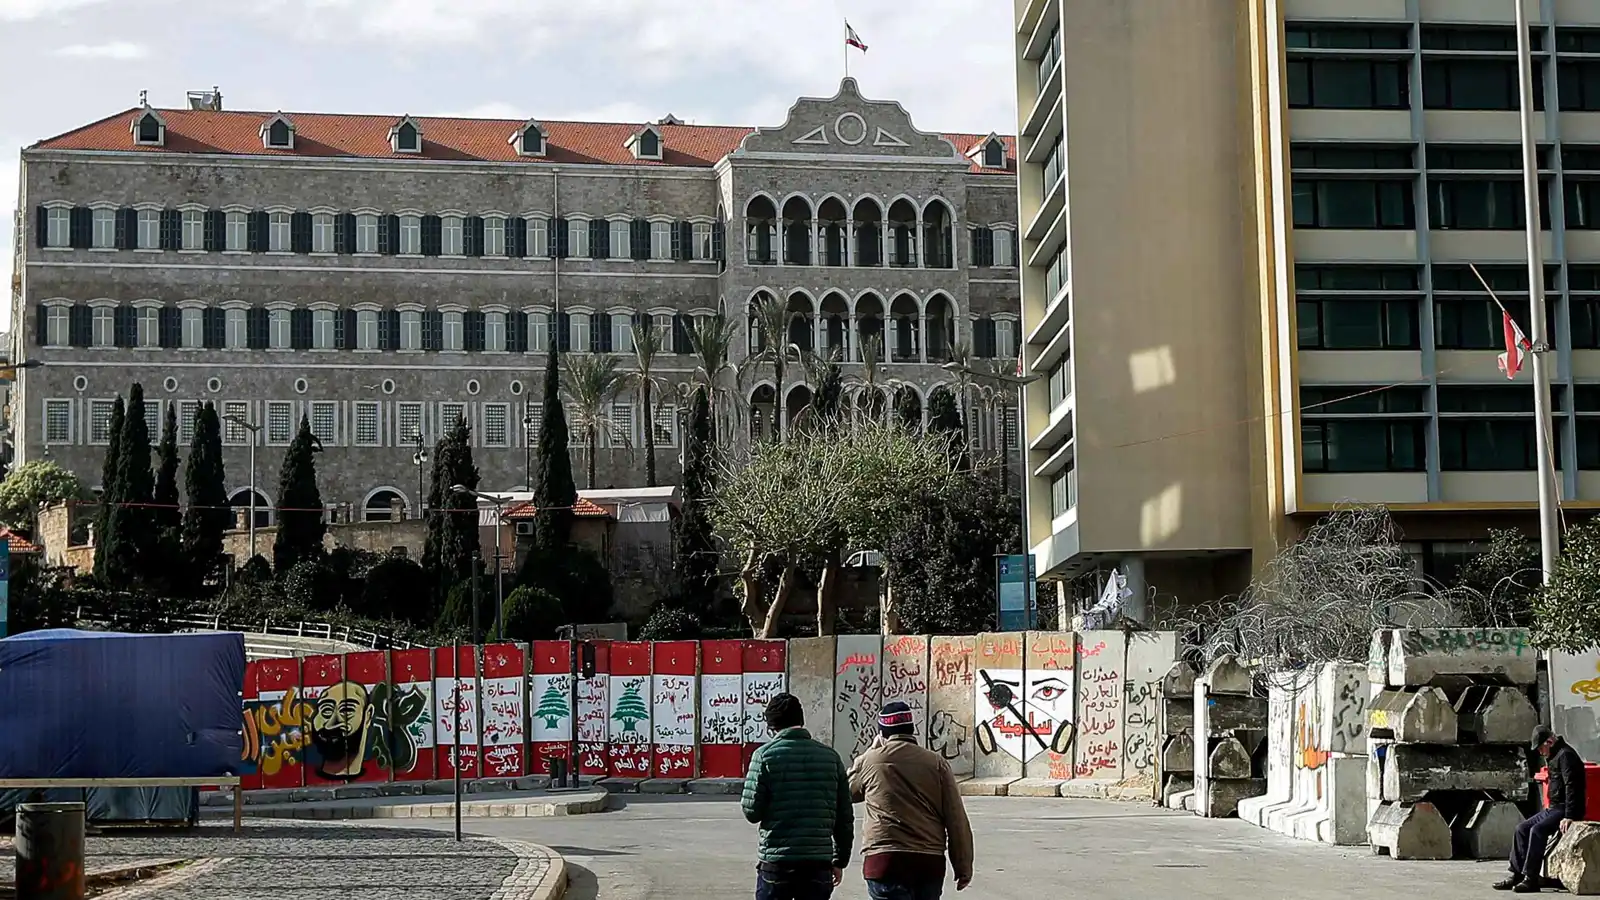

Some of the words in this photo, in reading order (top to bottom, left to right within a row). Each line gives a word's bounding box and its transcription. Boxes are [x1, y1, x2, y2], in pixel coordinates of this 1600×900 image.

[889, 659, 921, 680] نسخة
[487, 680, 521, 699] السفارة
[904, 677, 926, 694] جدار
